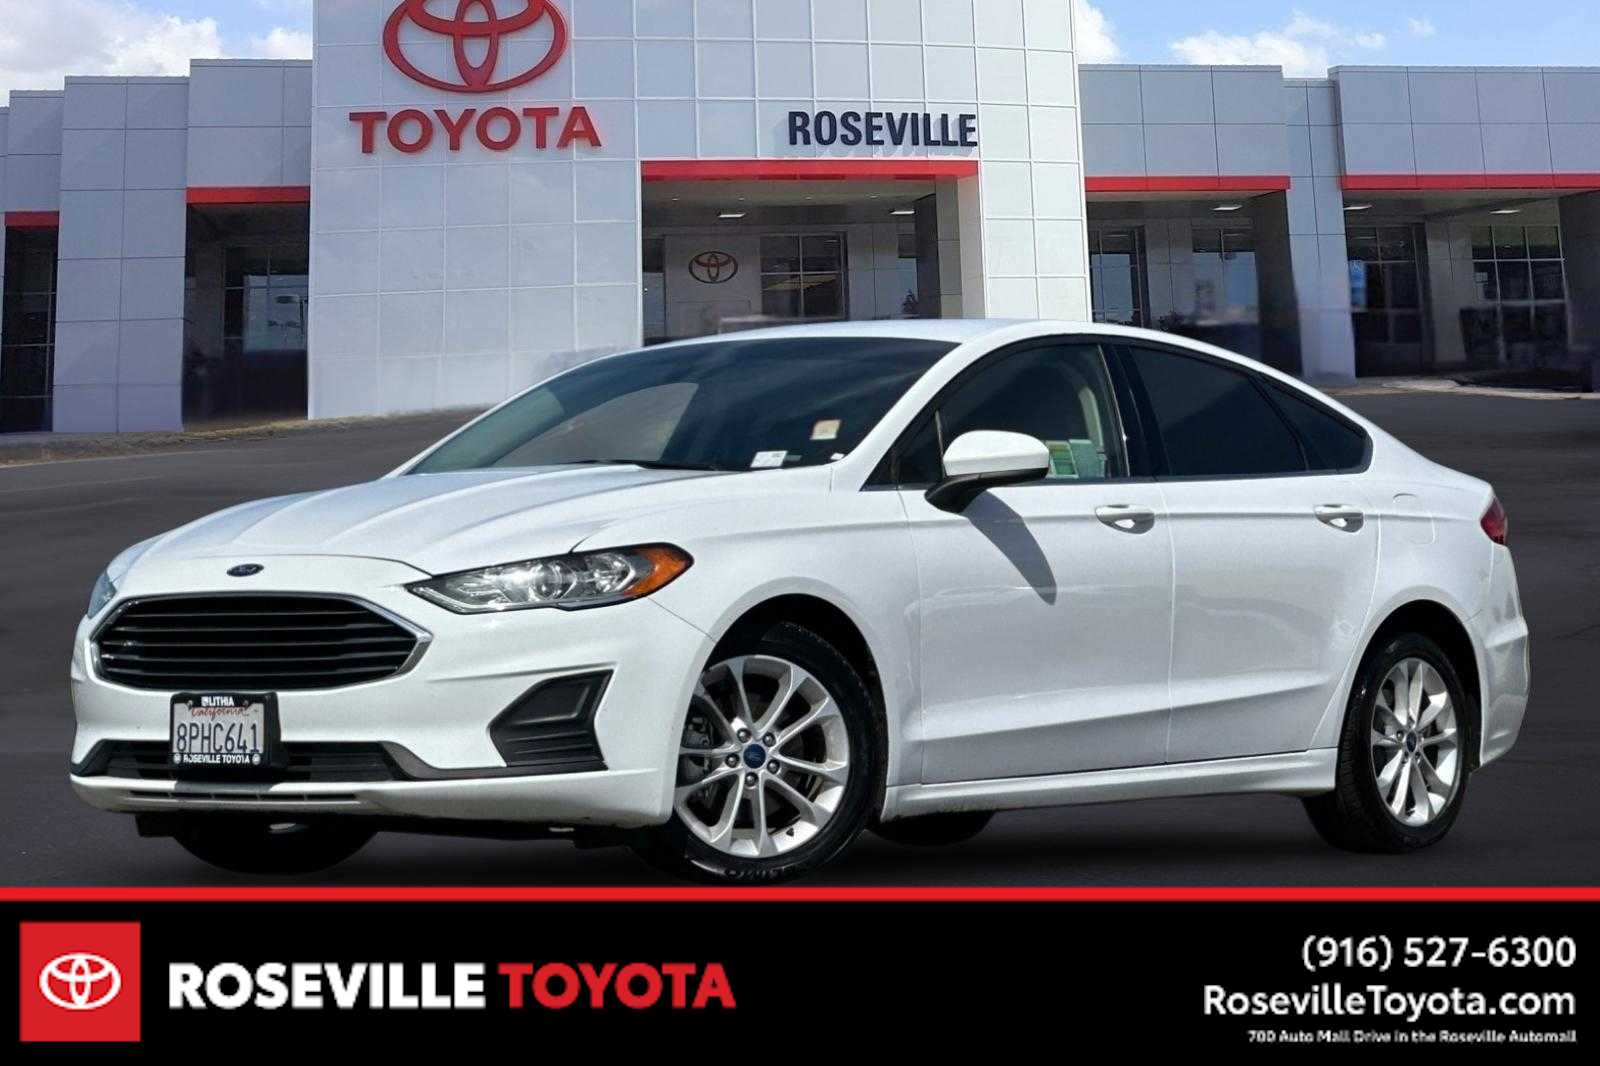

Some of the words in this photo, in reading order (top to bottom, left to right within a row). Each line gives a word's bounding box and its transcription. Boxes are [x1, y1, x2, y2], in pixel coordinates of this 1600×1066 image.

[349, 106, 602, 154] TOYOTA
[788, 111, 978, 147] ROSEVILLE
[176, 722, 260, 753] 8PHC641
[183, 754, 221, 764] ROSEVILLE
[222, 754, 250, 764] TOYOTA
